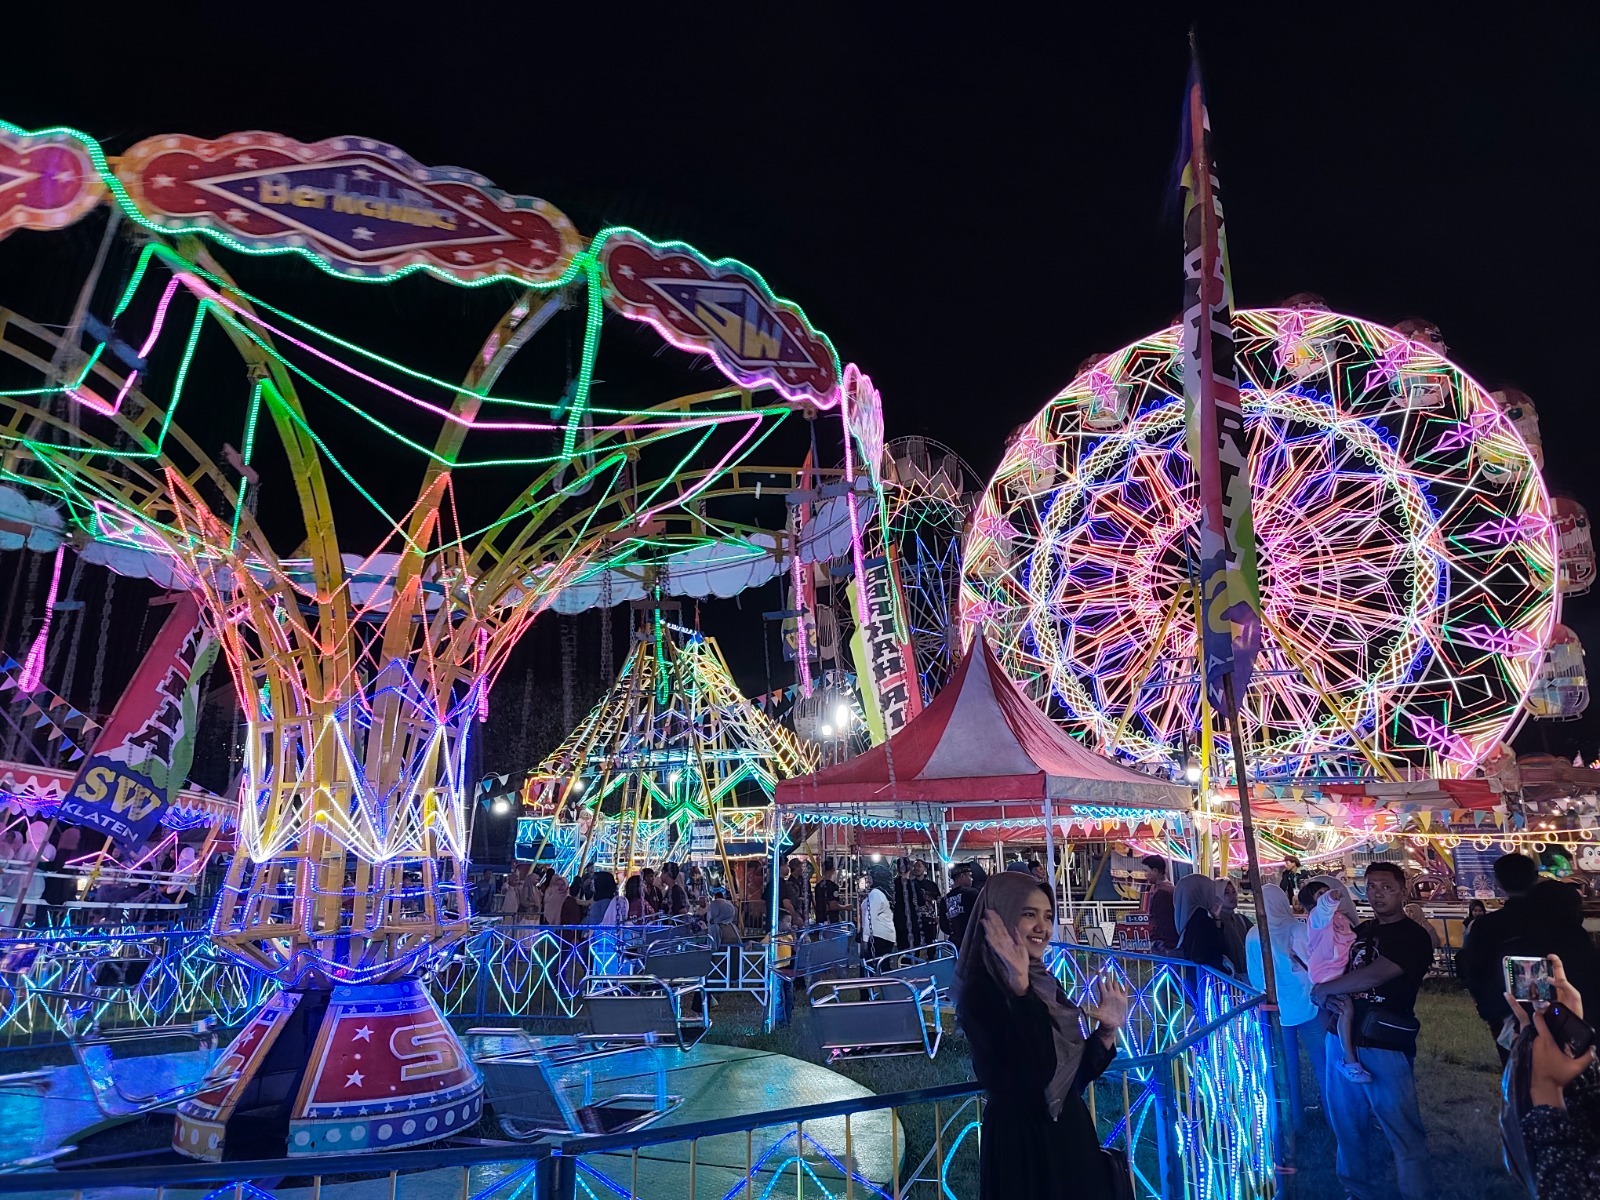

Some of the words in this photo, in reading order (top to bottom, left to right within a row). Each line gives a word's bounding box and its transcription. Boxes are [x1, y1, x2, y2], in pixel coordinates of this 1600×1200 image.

[695, 288, 784, 360] SW
[61, 801, 139, 843] KLATEN
[75, 766, 161, 822] SW
